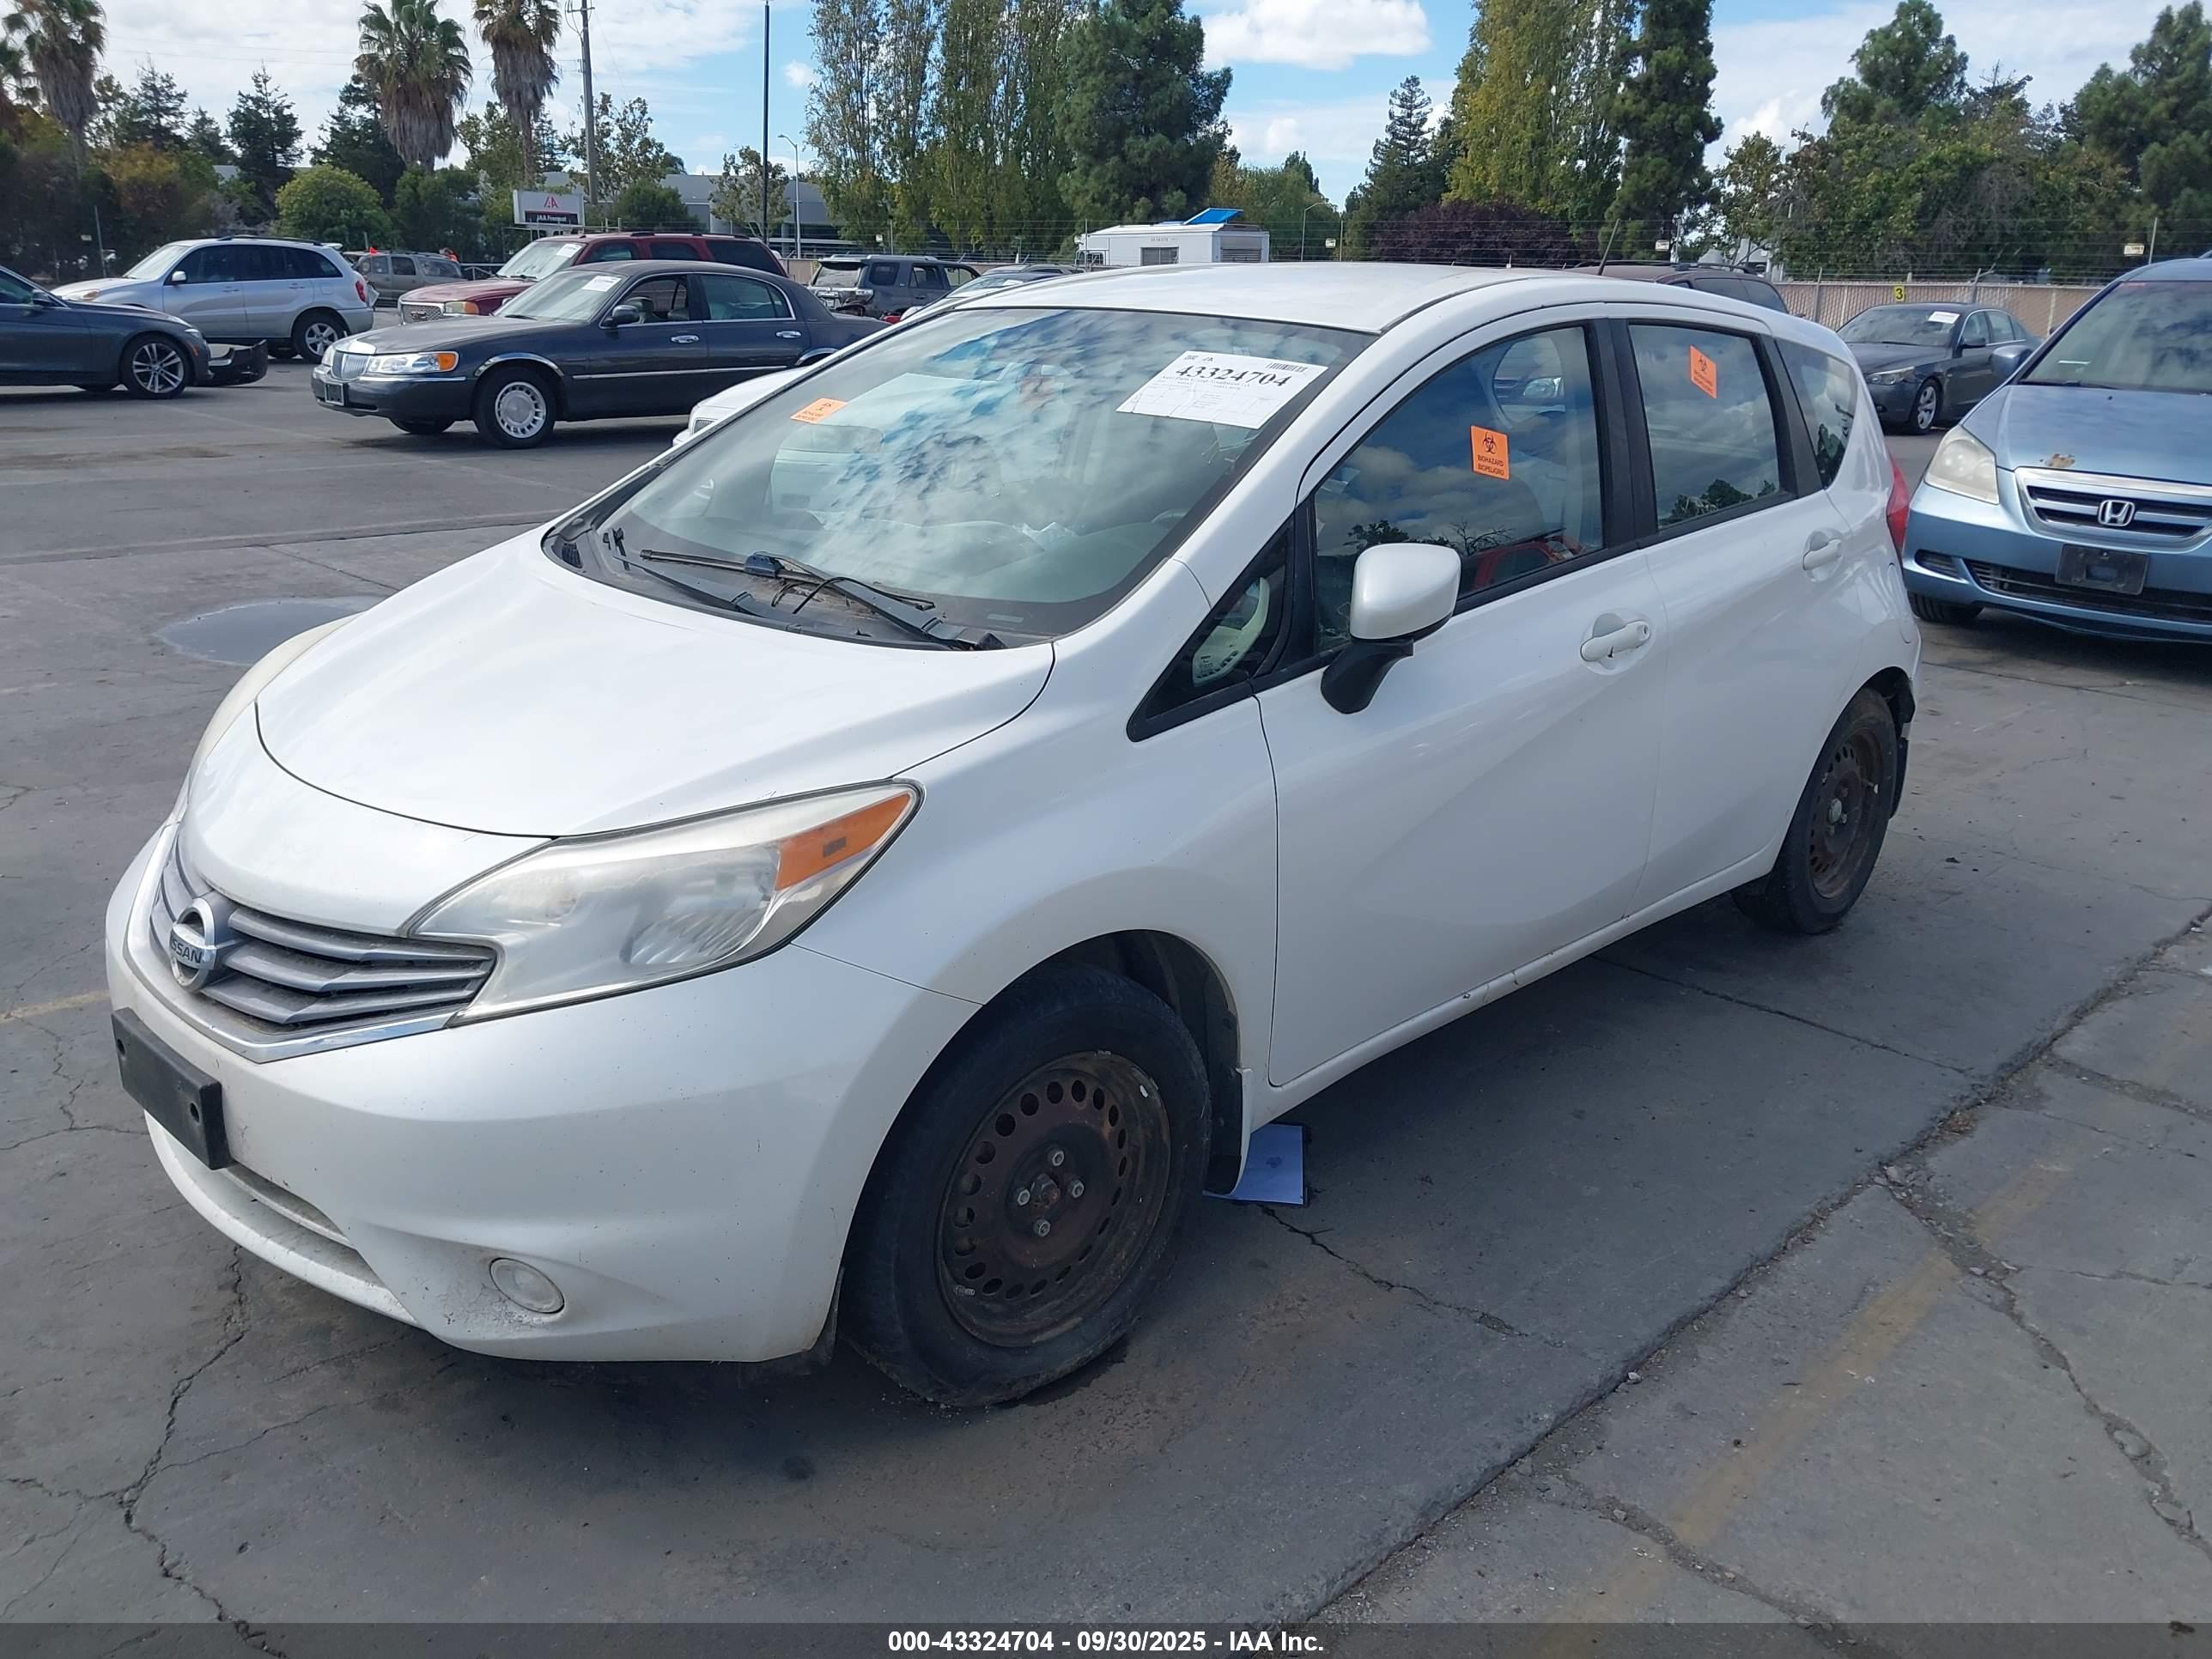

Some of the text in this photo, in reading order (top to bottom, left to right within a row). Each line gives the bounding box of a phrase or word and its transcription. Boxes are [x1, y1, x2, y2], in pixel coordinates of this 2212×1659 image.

[1895, 288, 1904, 300] 3
[1175, 364, 1293, 387] 43324704
[171, 939, 203, 964] SSAN
